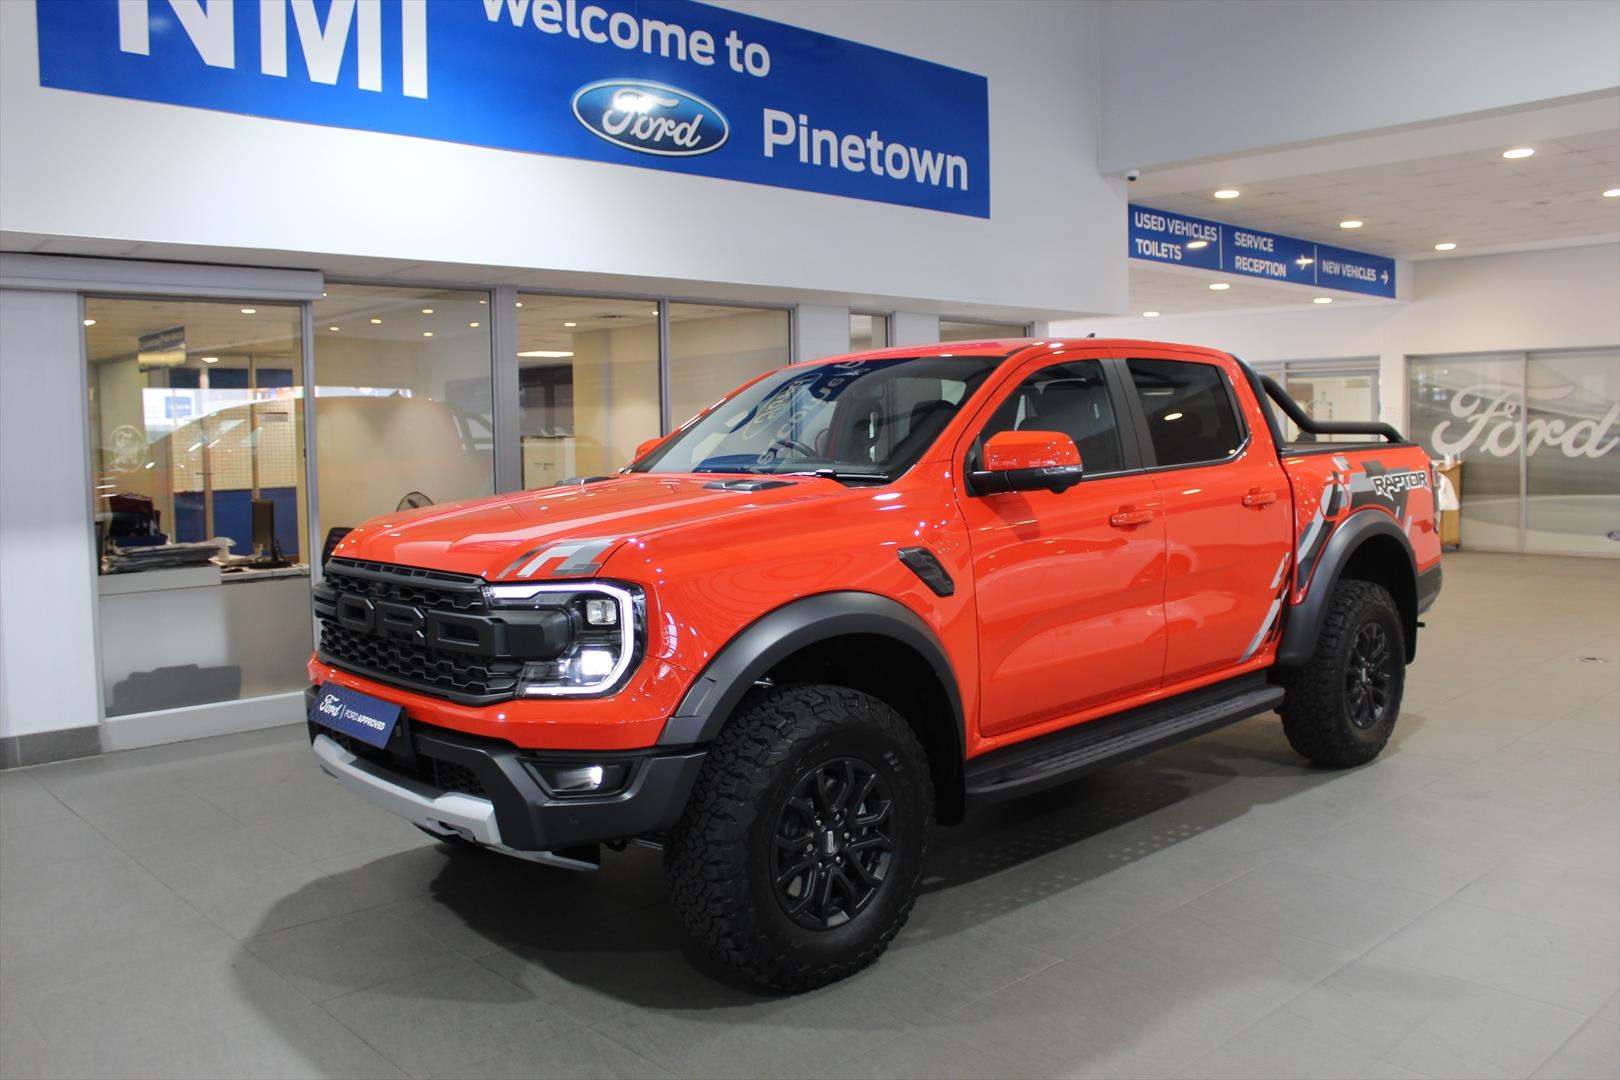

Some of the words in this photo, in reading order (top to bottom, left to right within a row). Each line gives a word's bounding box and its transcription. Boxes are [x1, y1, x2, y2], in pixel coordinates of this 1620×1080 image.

[725, 30, 770, 77] to
[601, 86, 705, 149] Ford
[763, 108, 968, 190] Pinetown
[1135, 211, 1166, 232] USED
[1167, 217, 1218, 242] VEHICLES
[1234, 231, 1275, 252] SERVICE
[1135, 238, 1182, 260] TOILETS
[1235, 255, 1287, 277] RECEPTION
[1322, 260, 1341, 276] NEW
[1341, 263, 1377, 282] VEHICLES
[1431, 383, 1620, 458] Ford
[1370, 470, 1431, 501] RAPTOR
[319, 694, 343, 716] Ford
[344, 709, 359, 721] FORD
[357, 714, 386, 731] APPROVED
